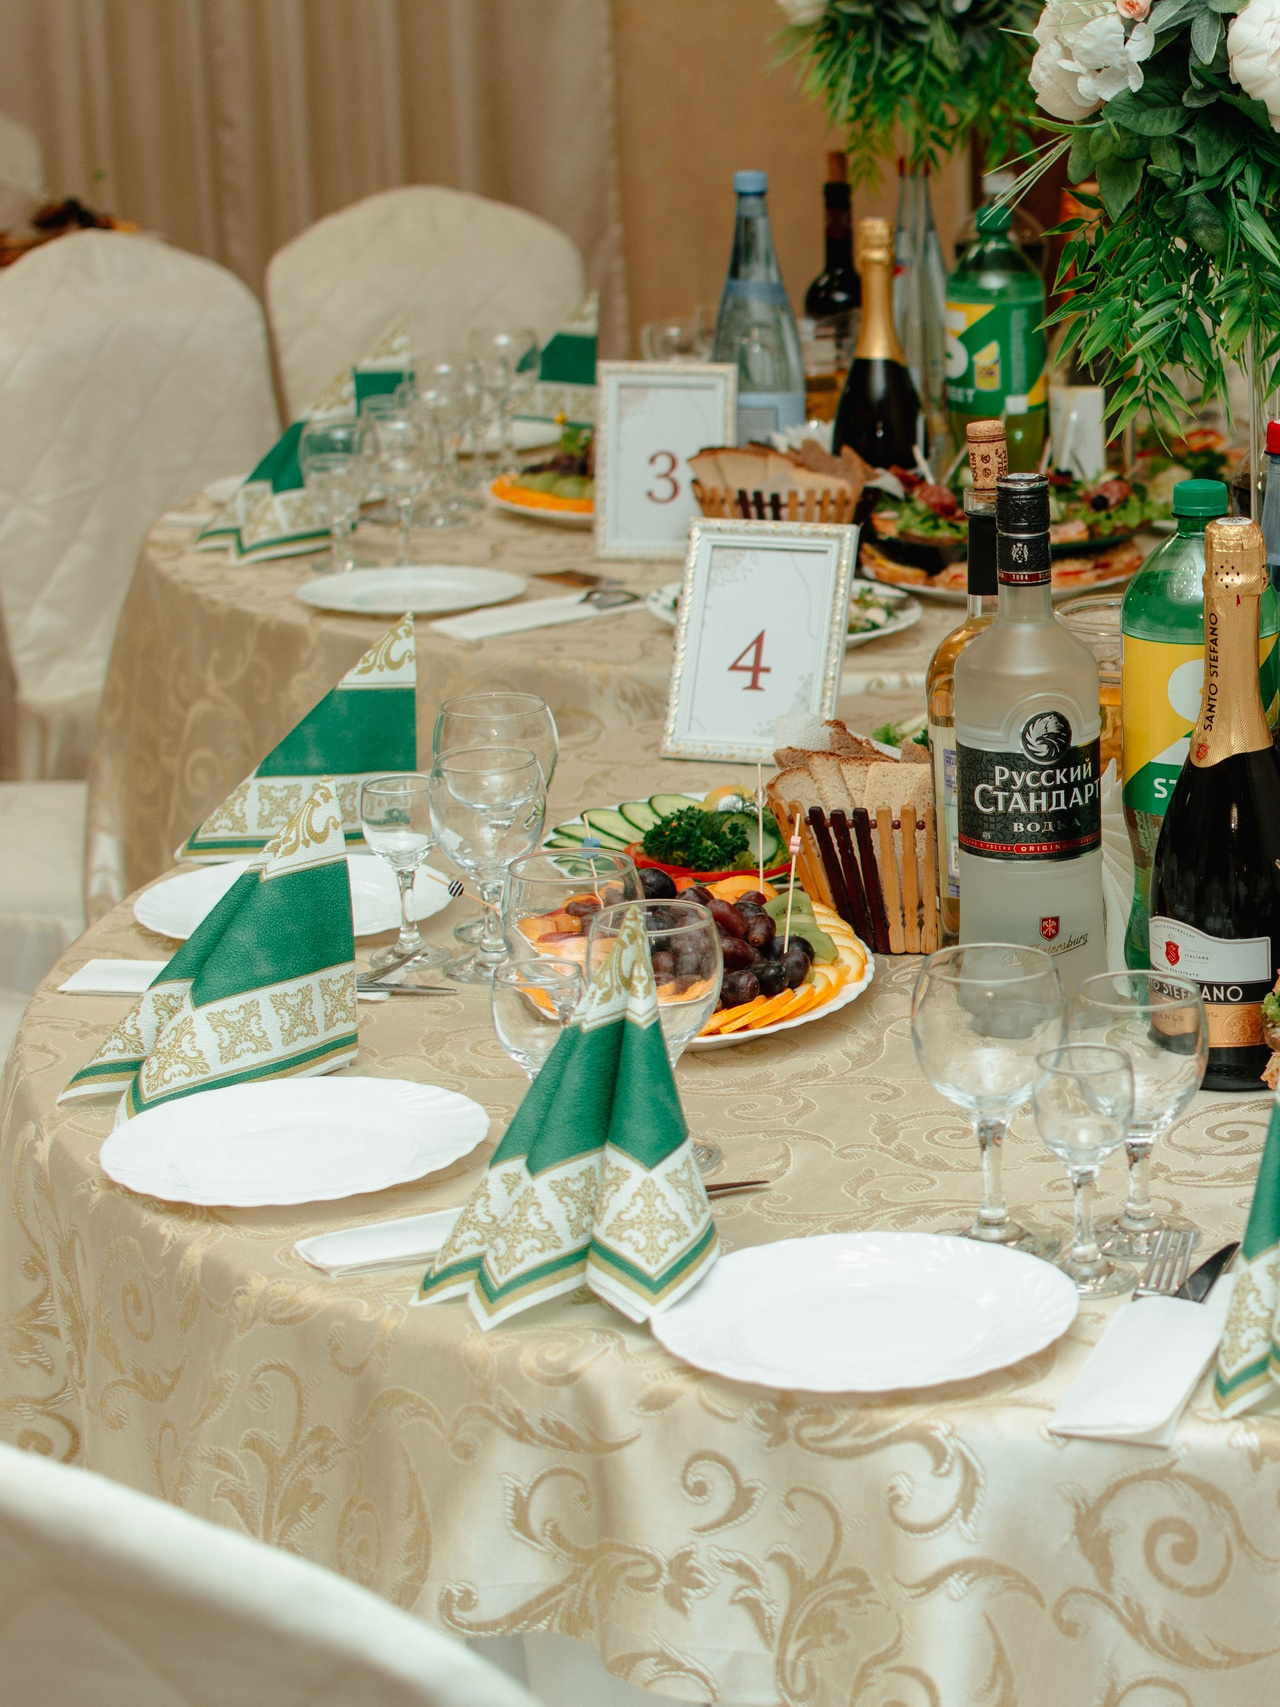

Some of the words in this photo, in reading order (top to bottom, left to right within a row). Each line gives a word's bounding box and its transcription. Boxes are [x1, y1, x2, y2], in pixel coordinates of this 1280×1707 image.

[646, 450, 681, 504] 3
[727, 628, 772, 692] 4
[1209, 612, 1220, 679] STEFANO
[1203, 683, 1219, 732] SANTO
